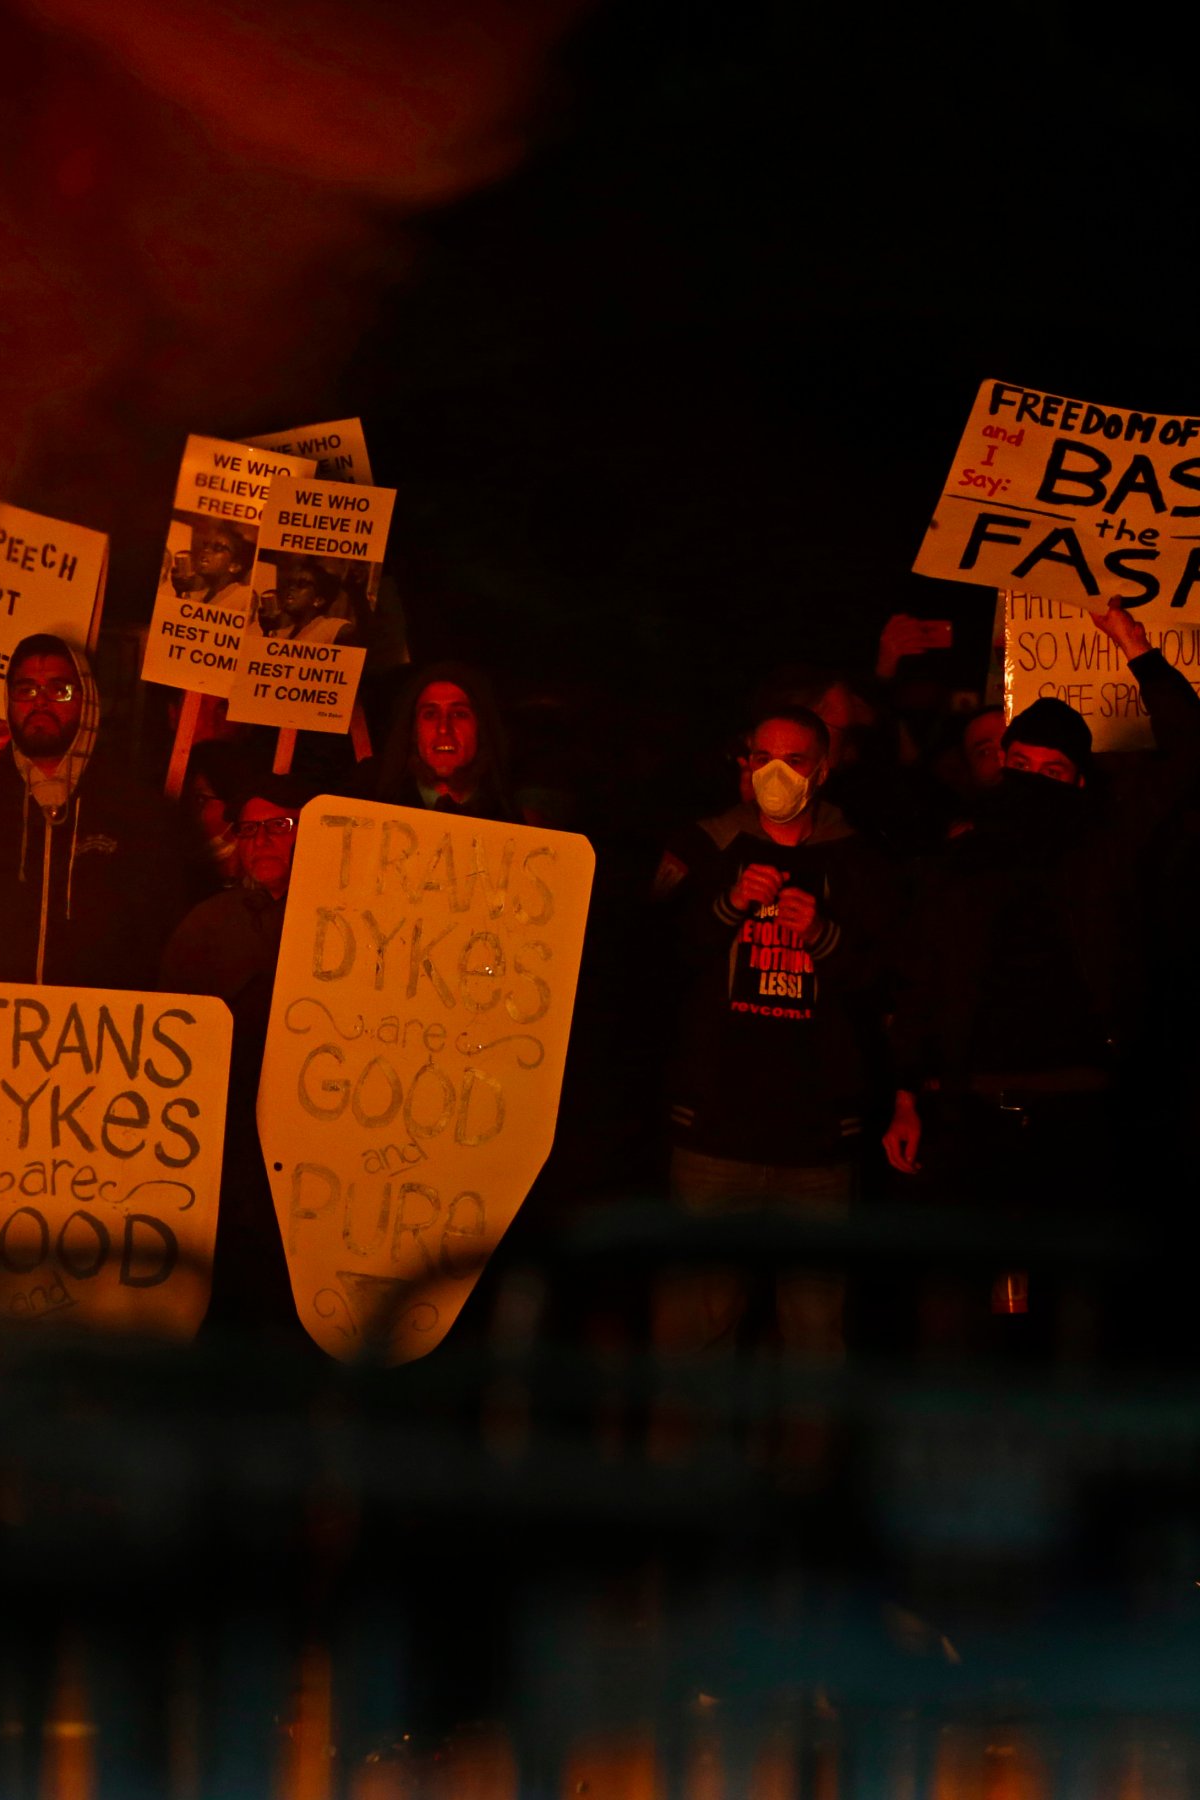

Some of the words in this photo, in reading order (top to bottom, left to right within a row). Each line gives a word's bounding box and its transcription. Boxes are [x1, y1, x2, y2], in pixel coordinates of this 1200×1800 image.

[988, 383, 1156, 443] FREEDOM
[1159, 420, 1200, 447] OF
[297, 434, 341, 455] WHO
[982, 424, 1025, 447] and
[213, 453, 243, 471] WE
[247, 458, 291, 477] WHO
[335, 454, 353, 471] IN
[981, 444, 998, 467] I
[195, 472, 269, 500] BELIEVE
[295, 490, 323, 508] WE
[328, 494, 370, 512] WHO
[278, 511, 350, 533] BELIEVE
[355, 520, 374, 535] IN
[1096, 518, 1159, 547] the
[280, 533, 368, 556] FREEDOM
[161, 622, 207, 644] REST
[168, 644, 185, 660] IT
[190, 650, 237, 672] COM
[266, 642, 341, 663] CANNOT
[1018, 631, 1057, 671] SO
[248, 661, 294, 681] REST
[298, 666, 348, 685] UNTIL
[253, 684, 270, 698] IT
[275, 685, 338, 705] COMES
[319, 815, 556, 927] TRANS
[759, 971, 803, 999] LESS!
[377, 1017, 447, 1053] are
[297, 1043, 505, 1147] GOOD
[362, 1138, 428, 1176] and
[18, 1158, 98, 1202] are
